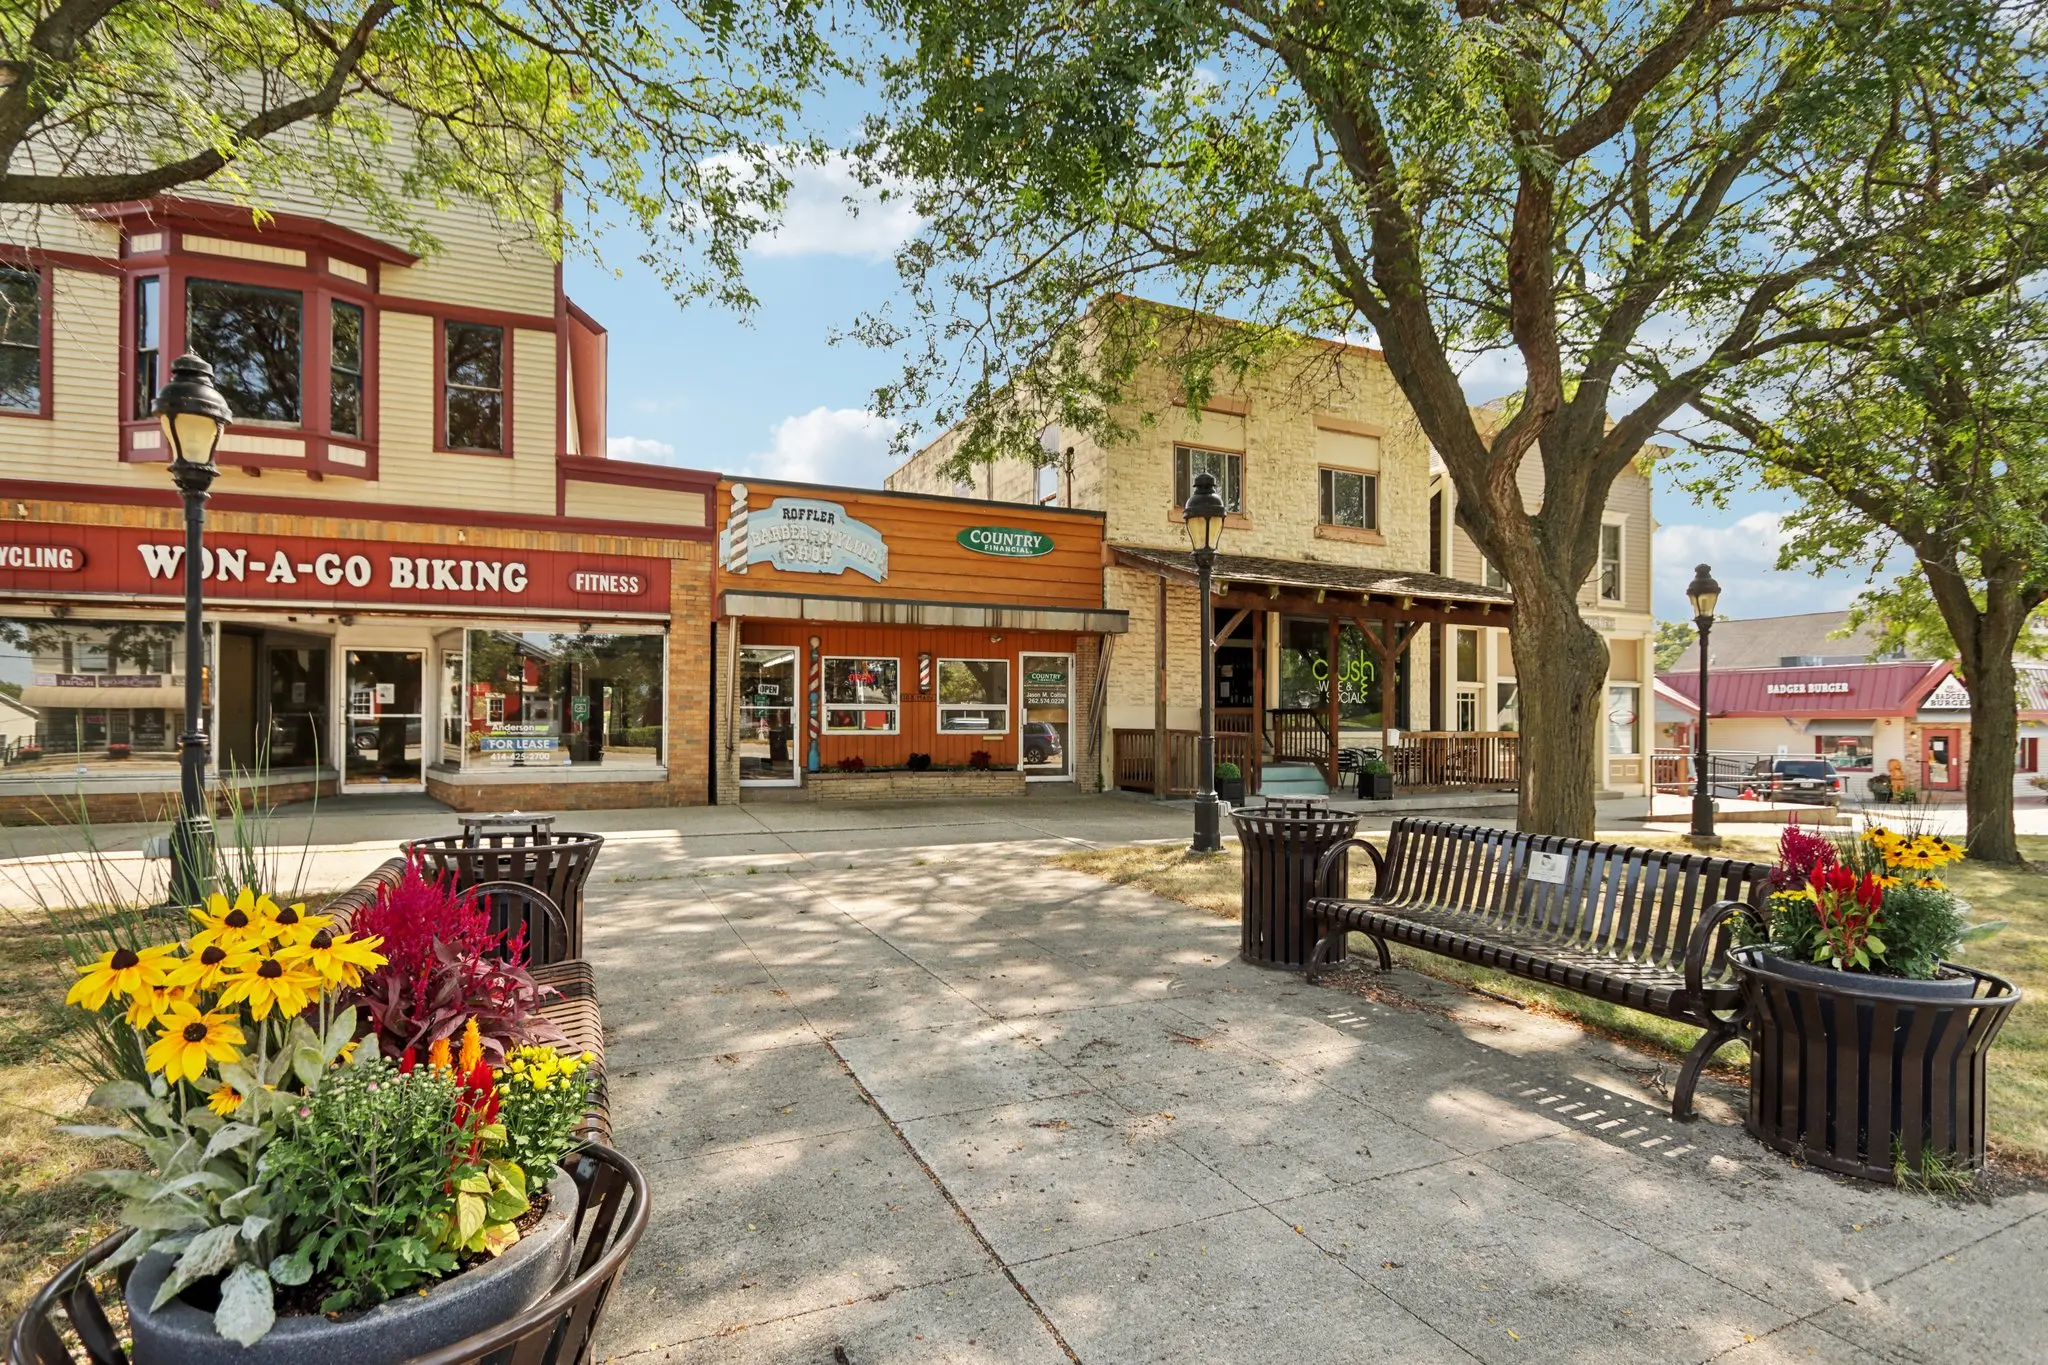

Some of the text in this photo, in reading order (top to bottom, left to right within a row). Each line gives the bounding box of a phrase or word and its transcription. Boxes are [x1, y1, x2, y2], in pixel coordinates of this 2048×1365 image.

[783, 508, 835, 524] ROFFLER
[750, 524, 878, 563] BARBER-STYLING
[970, 529, 1042, 548] COUNTRY
[0, 546, 73, 569] YCLING
[786, 545, 832, 564] SHOP
[389, 556, 528, 593] BIKING
[576, 573, 639, 593] FITNESS
[1312, 649, 1374, 682] cush
[848, 673, 875, 684] OPEN
[1319, 680, 1353, 692] WE &
[760, 685, 777, 694] OPEN
[1767, 682, 1849, 694] BADGER BURGER
[1326, 691, 1363, 703] CIAL
[491, 723, 535, 731] Anderson
[490, 739, 550, 749] FOR LEASE
